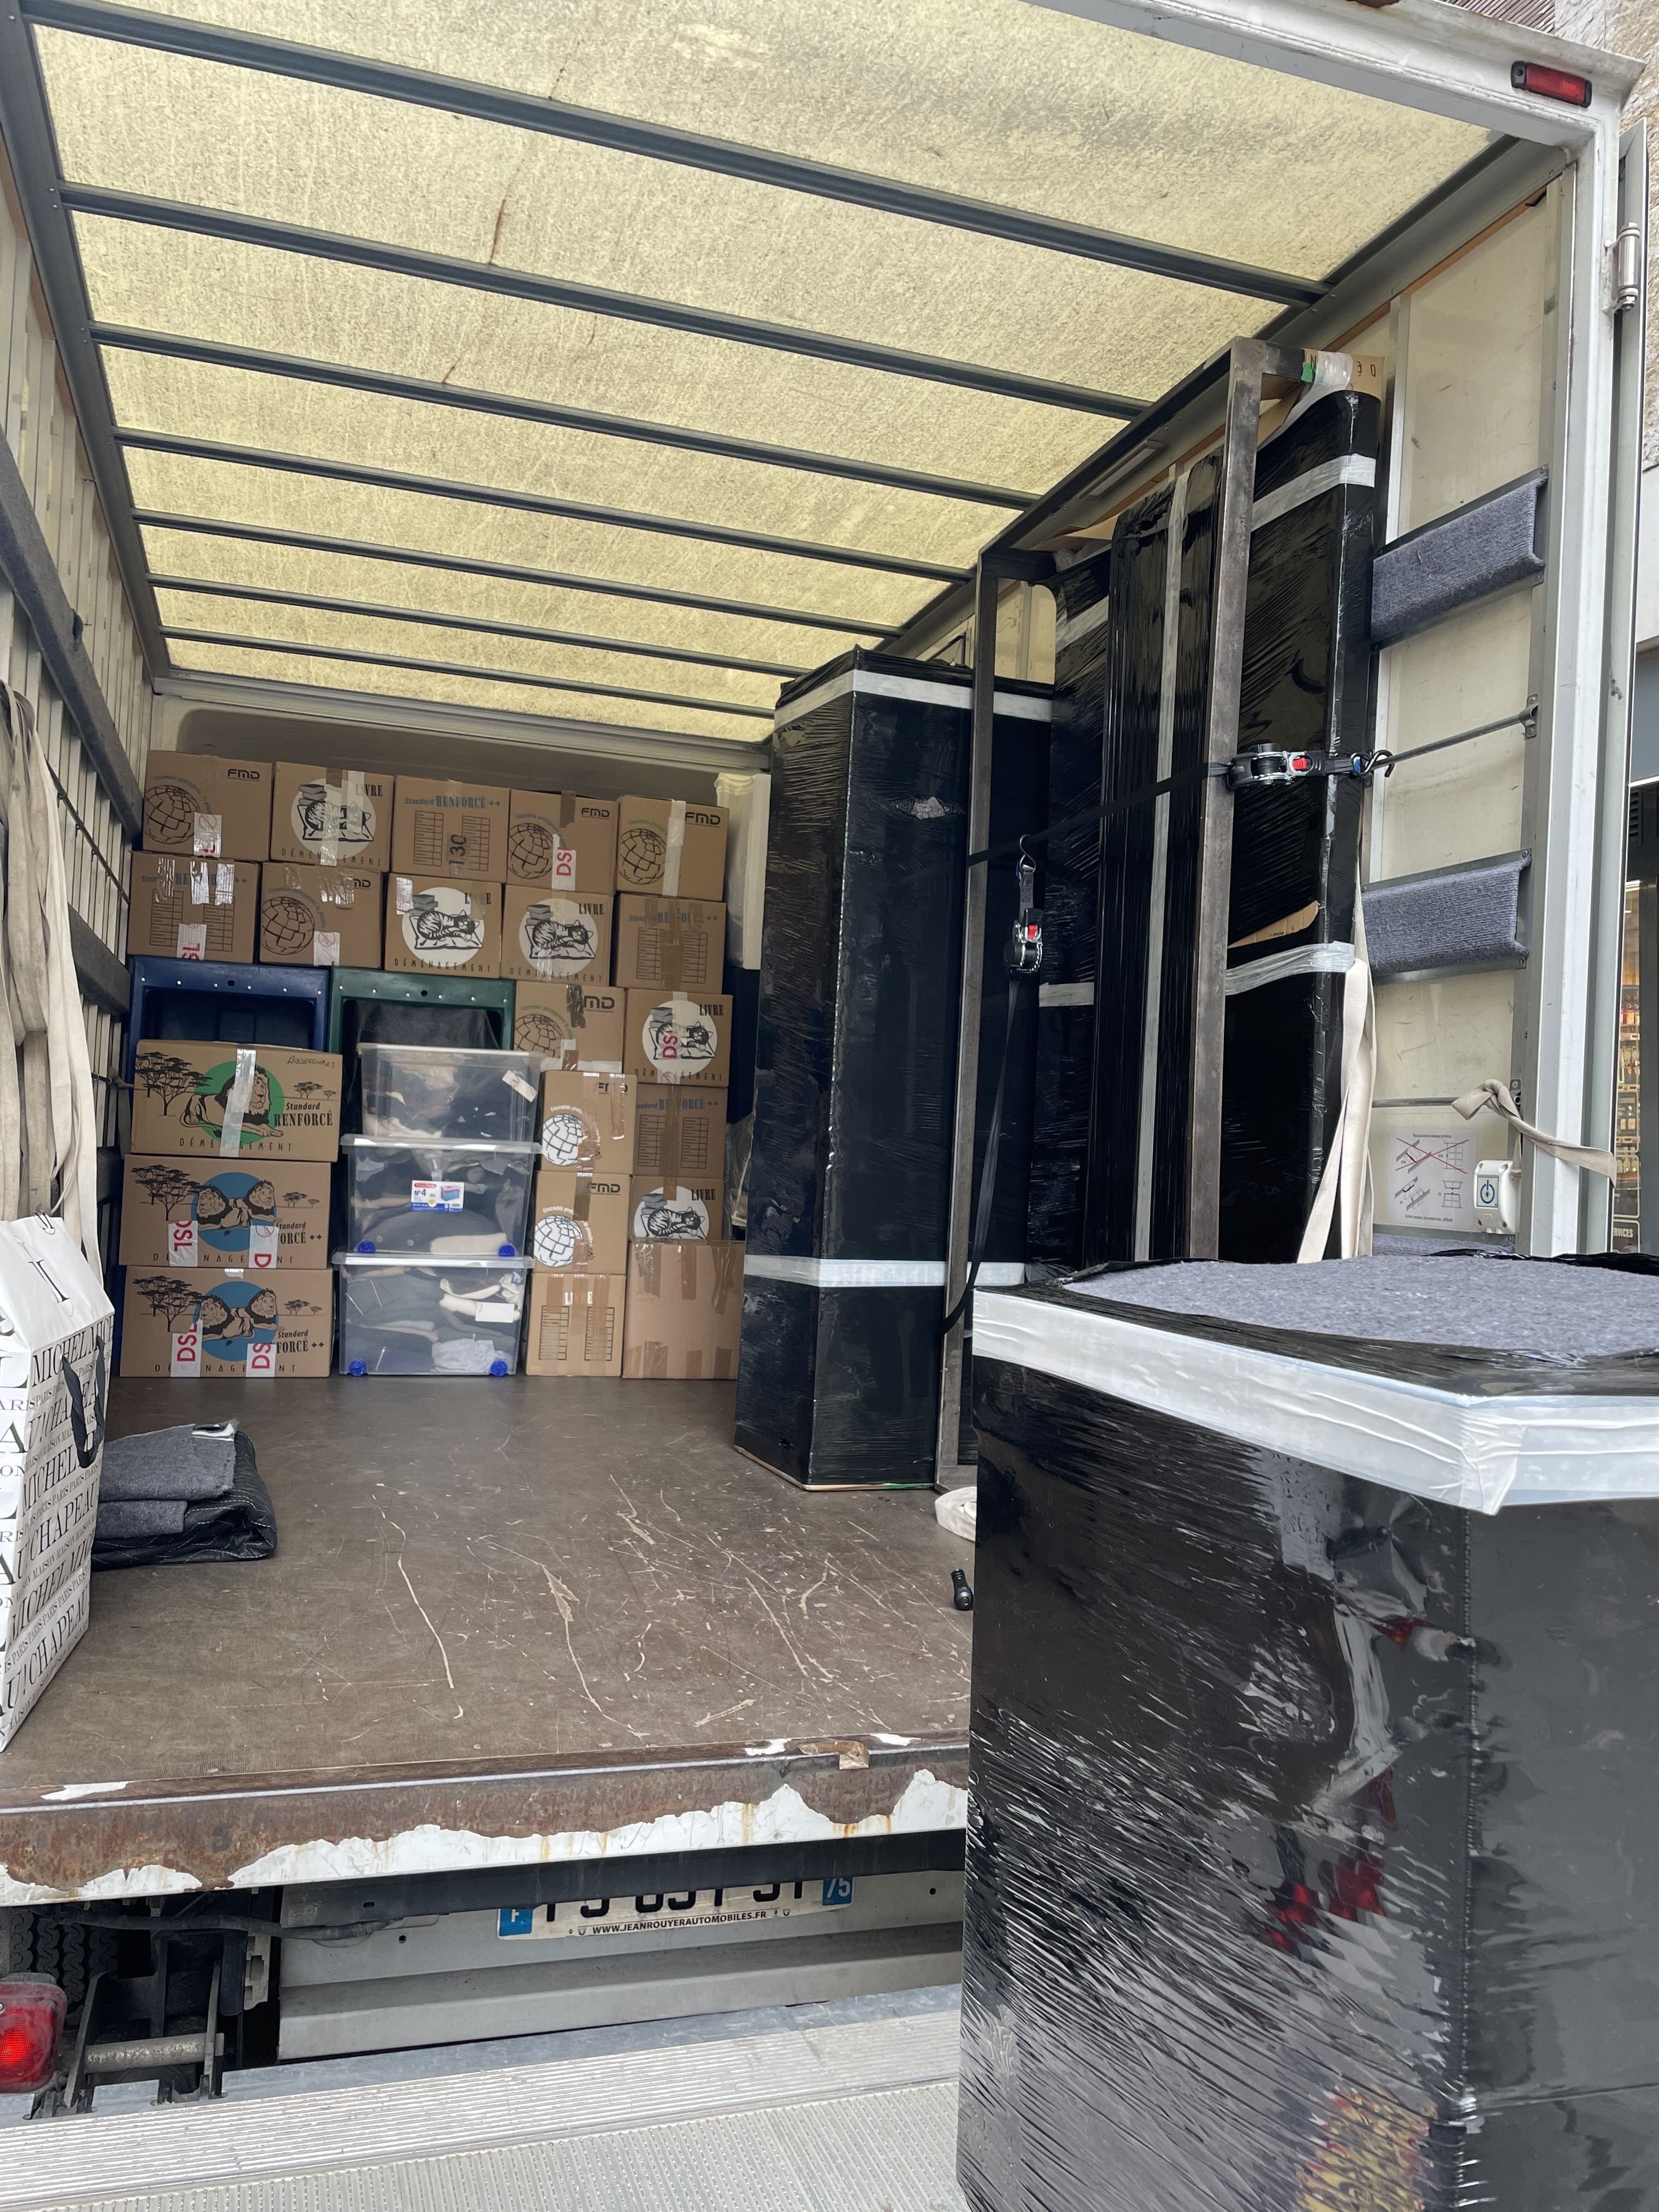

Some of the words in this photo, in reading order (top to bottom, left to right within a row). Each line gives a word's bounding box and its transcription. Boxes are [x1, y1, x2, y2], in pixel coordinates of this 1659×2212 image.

[228, 769, 260, 780] FMD
[405, 797, 434, 805] Standard
[436, 795, 486, 809] RENFORCÉ
[582, 808, 610, 817] FMD
[685, 812, 720, 825] FMD
[281, 847, 381, 866] DÉMÉNEMENT
[578, 903, 604, 915] LIVRE
[394, 958, 490, 972] DÉMÉNAGEMENT
[584, 996, 615, 1009] MD
[699, 1004, 724, 1015] LIVRE
[286, 1102, 320, 1110] Standard
[275, 1110, 333, 1126] RENFORCÉ
[179, 1137, 292, 1152] DÉMÉGEMENT
[691, 1189, 715, 1200] LIVRE
[1613, 1227, 1633, 1238] RVICES
[278, 1330, 308, 1338] Standard
[592, 1911, 766, 1934] WWW.JEANROUYERAUTOMOBILES.FR
